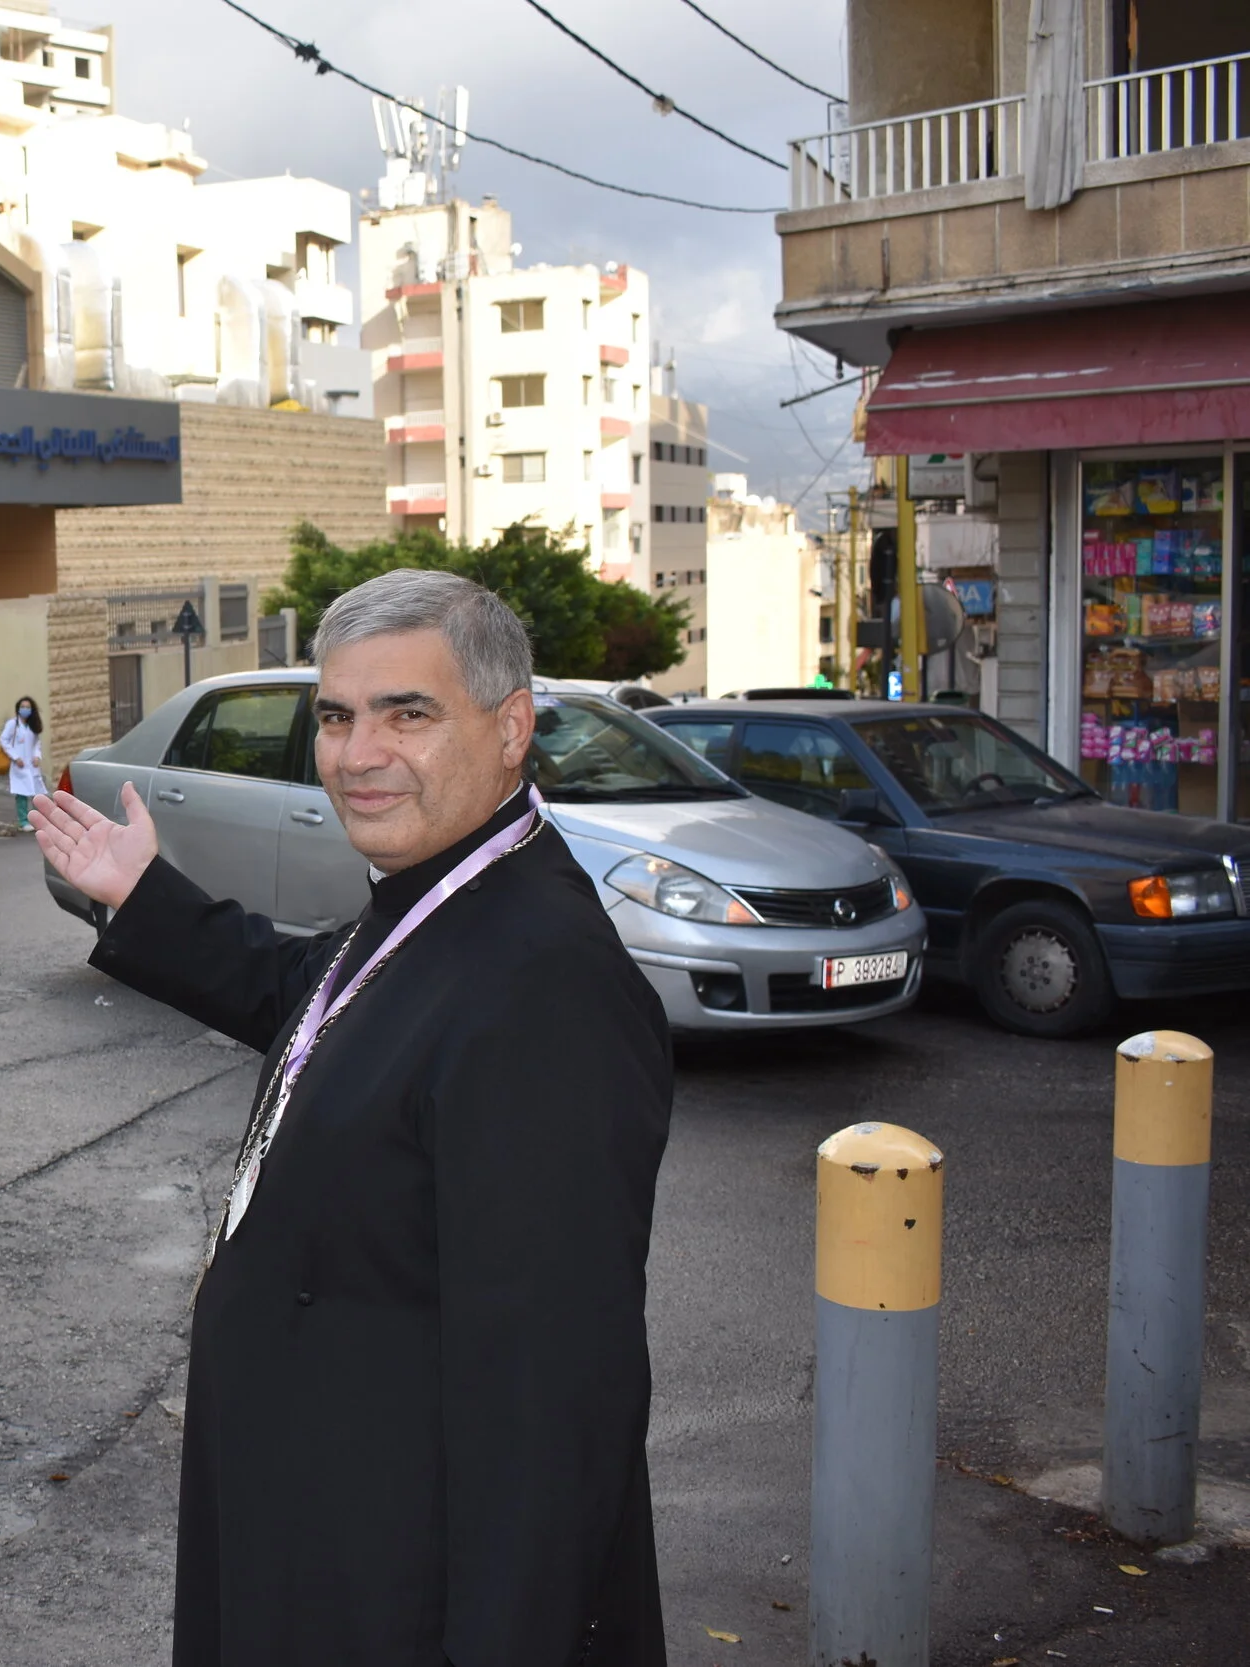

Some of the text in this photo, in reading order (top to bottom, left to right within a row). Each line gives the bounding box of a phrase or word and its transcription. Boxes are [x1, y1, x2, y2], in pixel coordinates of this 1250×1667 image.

[35, 427, 96, 470] اللبناني
[97, 425, 179, 464] المستشفى
[837, 961, 845, 984] P
